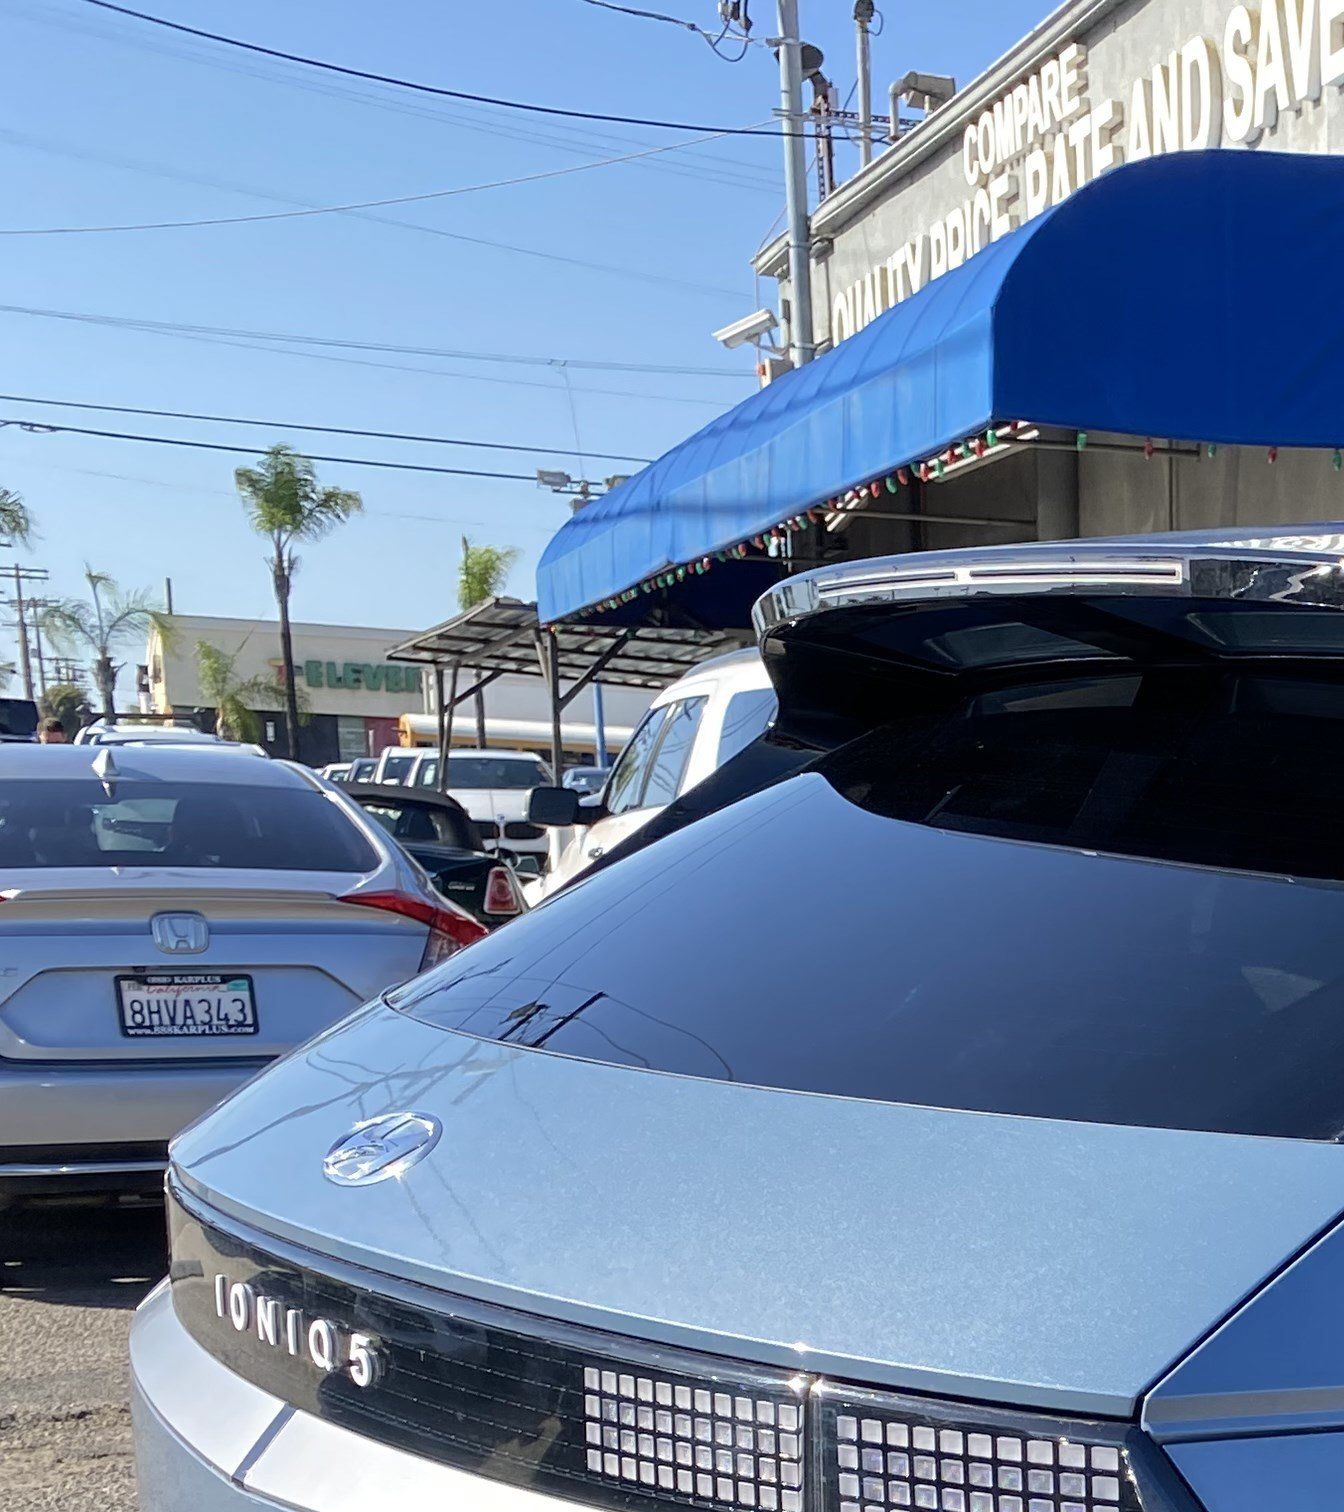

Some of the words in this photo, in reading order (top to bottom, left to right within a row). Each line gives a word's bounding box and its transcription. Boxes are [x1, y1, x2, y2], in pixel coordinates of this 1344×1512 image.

[963, 43, 1081, 186] COMPARE
[832, 233, 924, 348] QUALITY
[1127, 35, 1212, 163] AND
[130, 999, 248, 1026] 8HVA343
[215, 1274, 334, 1372] IONIQ
[349, 1333, 374, 1388] 5
